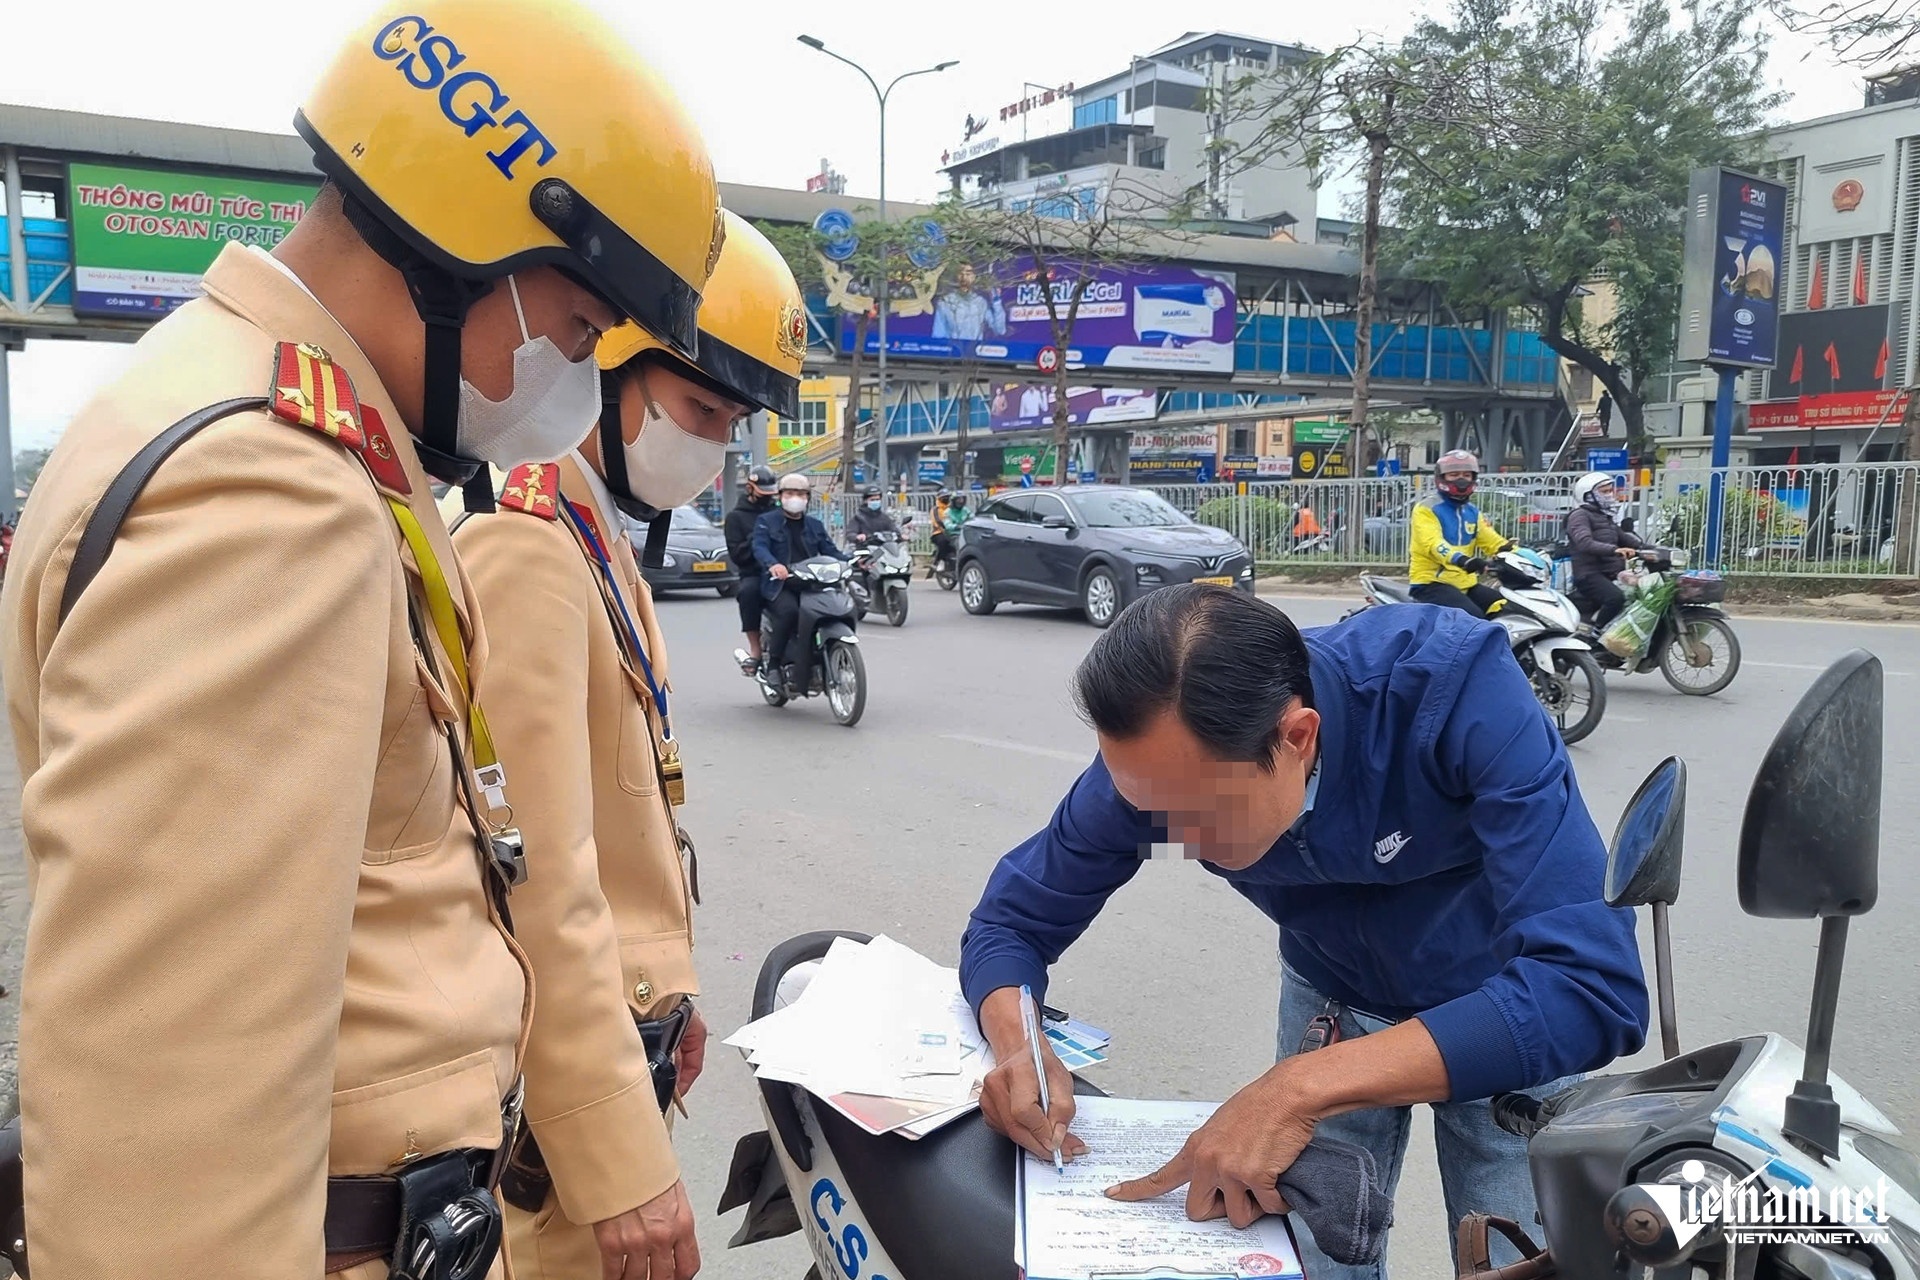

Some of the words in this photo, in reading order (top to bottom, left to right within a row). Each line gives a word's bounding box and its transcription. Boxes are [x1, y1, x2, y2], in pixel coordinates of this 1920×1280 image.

[372, 15, 558, 181] CSGT
[79, 184, 165, 211] THÔNG
[171, 193, 213, 216] MŨI
[219, 195, 264, 220] TỨC
[106, 214, 209, 239] OTOSAN
[214, 223, 284, 246] FORTE
[1096, 283, 1122, 300] Gel
[1375, 830, 1402, 856] NIKE
